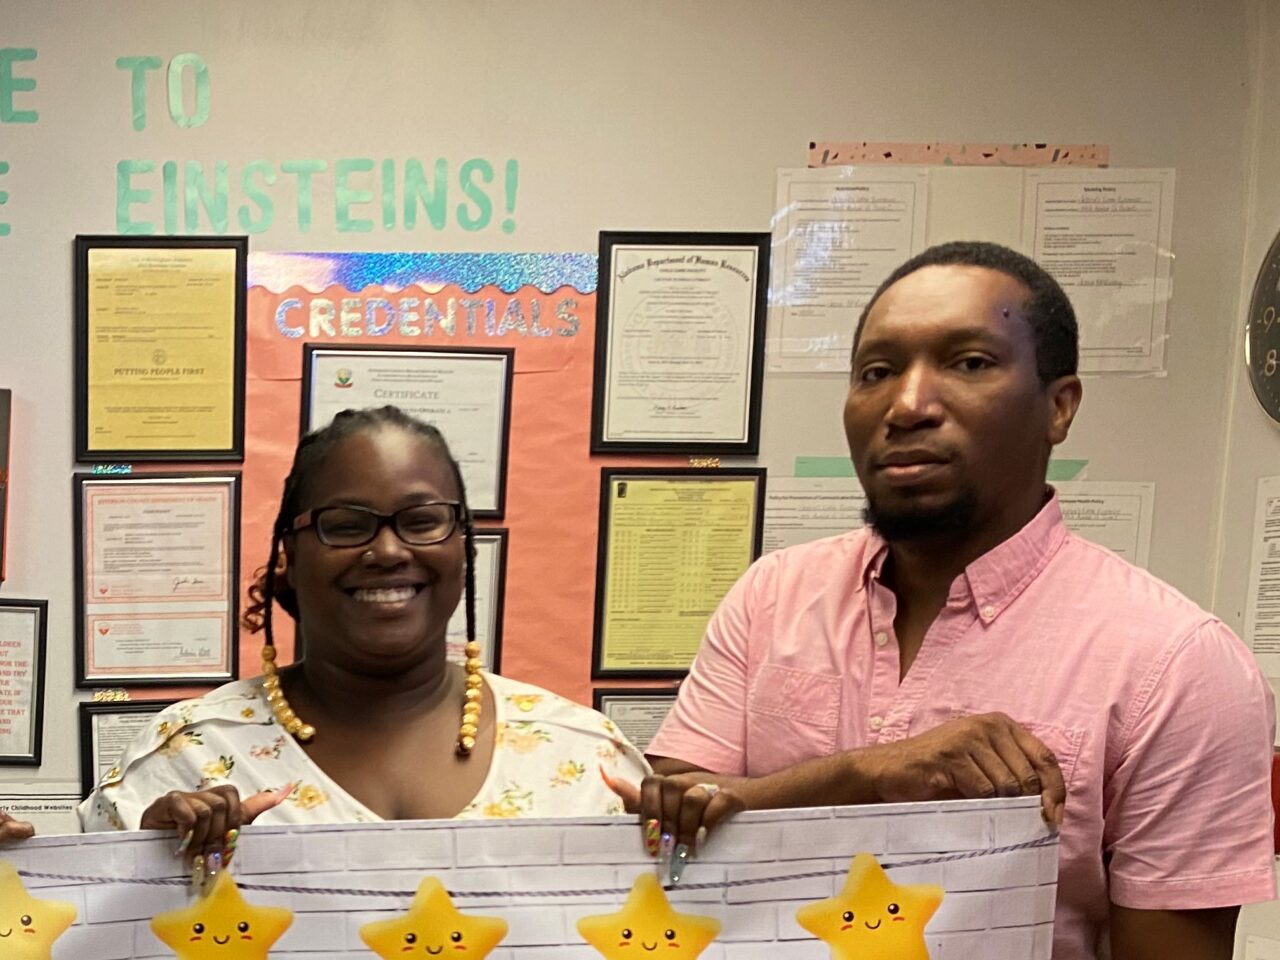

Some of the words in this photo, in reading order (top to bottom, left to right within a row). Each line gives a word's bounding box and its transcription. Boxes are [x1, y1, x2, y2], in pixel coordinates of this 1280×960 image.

[116, 52, 211, 131] TO
[116, 158, 519, 236] EINSTEINS!
[646, 255, 685, 268] Department
[274, 297, 582, 339] CREDENTIALS
[1264, 306, 1276, 334] 9
[114, 368, 149, 376] PUTTING
[150, 368, 181, 376] PEOPLE
[182, 367, 205, 376] FIRST
[1265, 349, 1277, 376] 8
